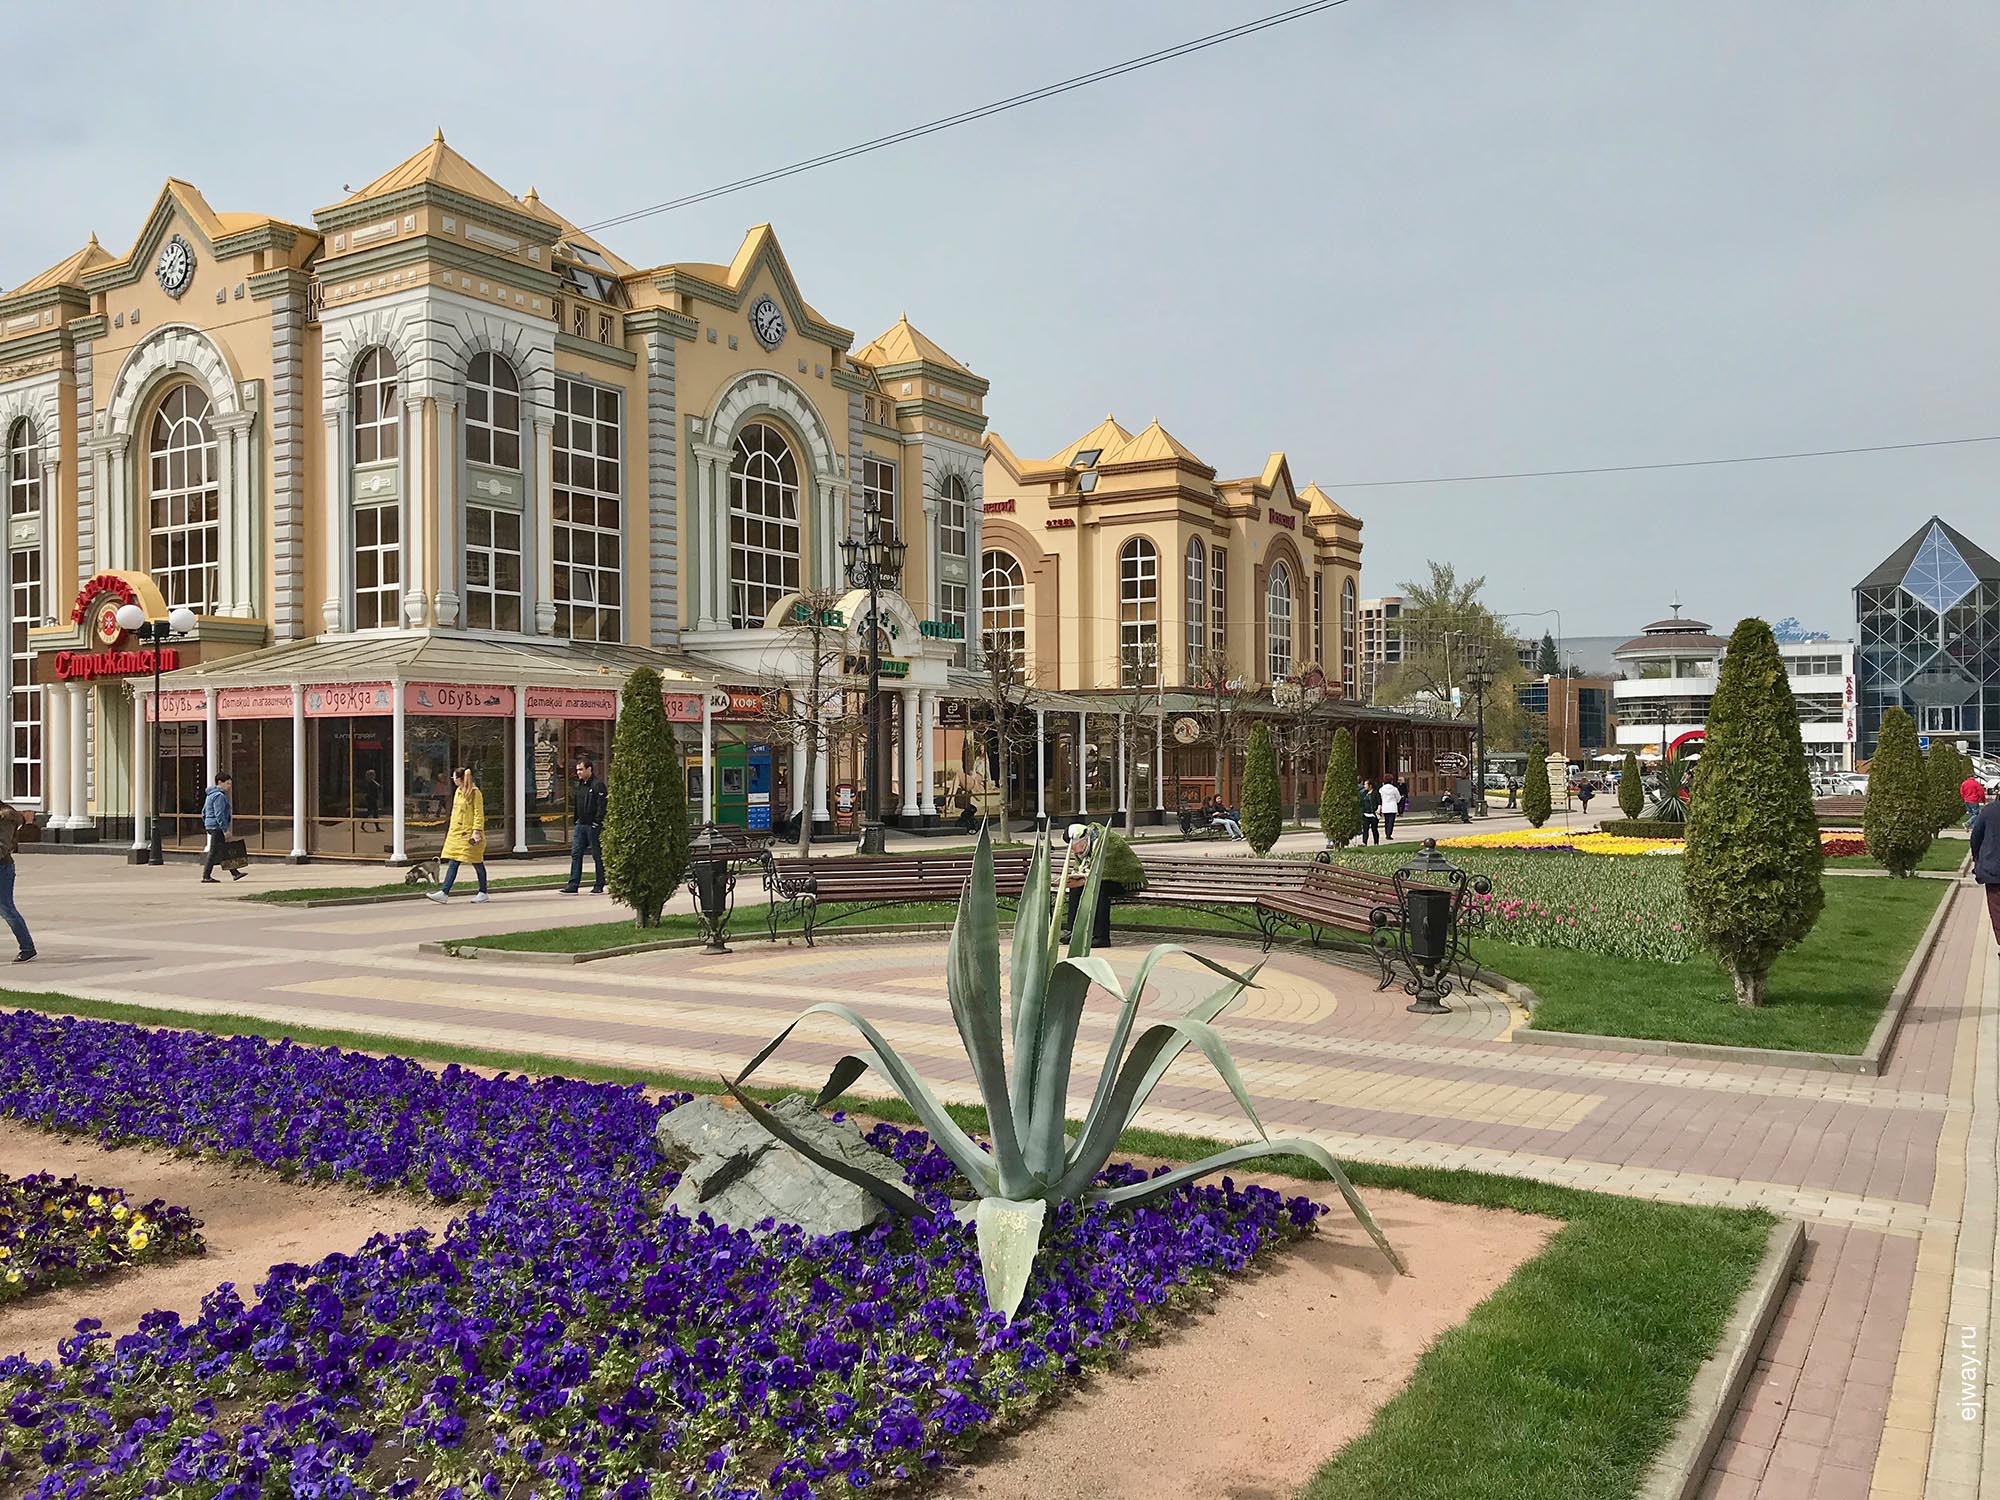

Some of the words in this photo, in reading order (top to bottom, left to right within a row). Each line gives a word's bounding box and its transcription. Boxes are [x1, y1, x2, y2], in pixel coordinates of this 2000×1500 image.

[71, 574, 142, 625] ВИНОТЕК
[795, 604, 848, 628] HTEL
[919, 620, 962, 640] ОТЕЛЬ
[326, 688, 371, 712] Одежда
[733, 697, 757, 708] КОФЕ
